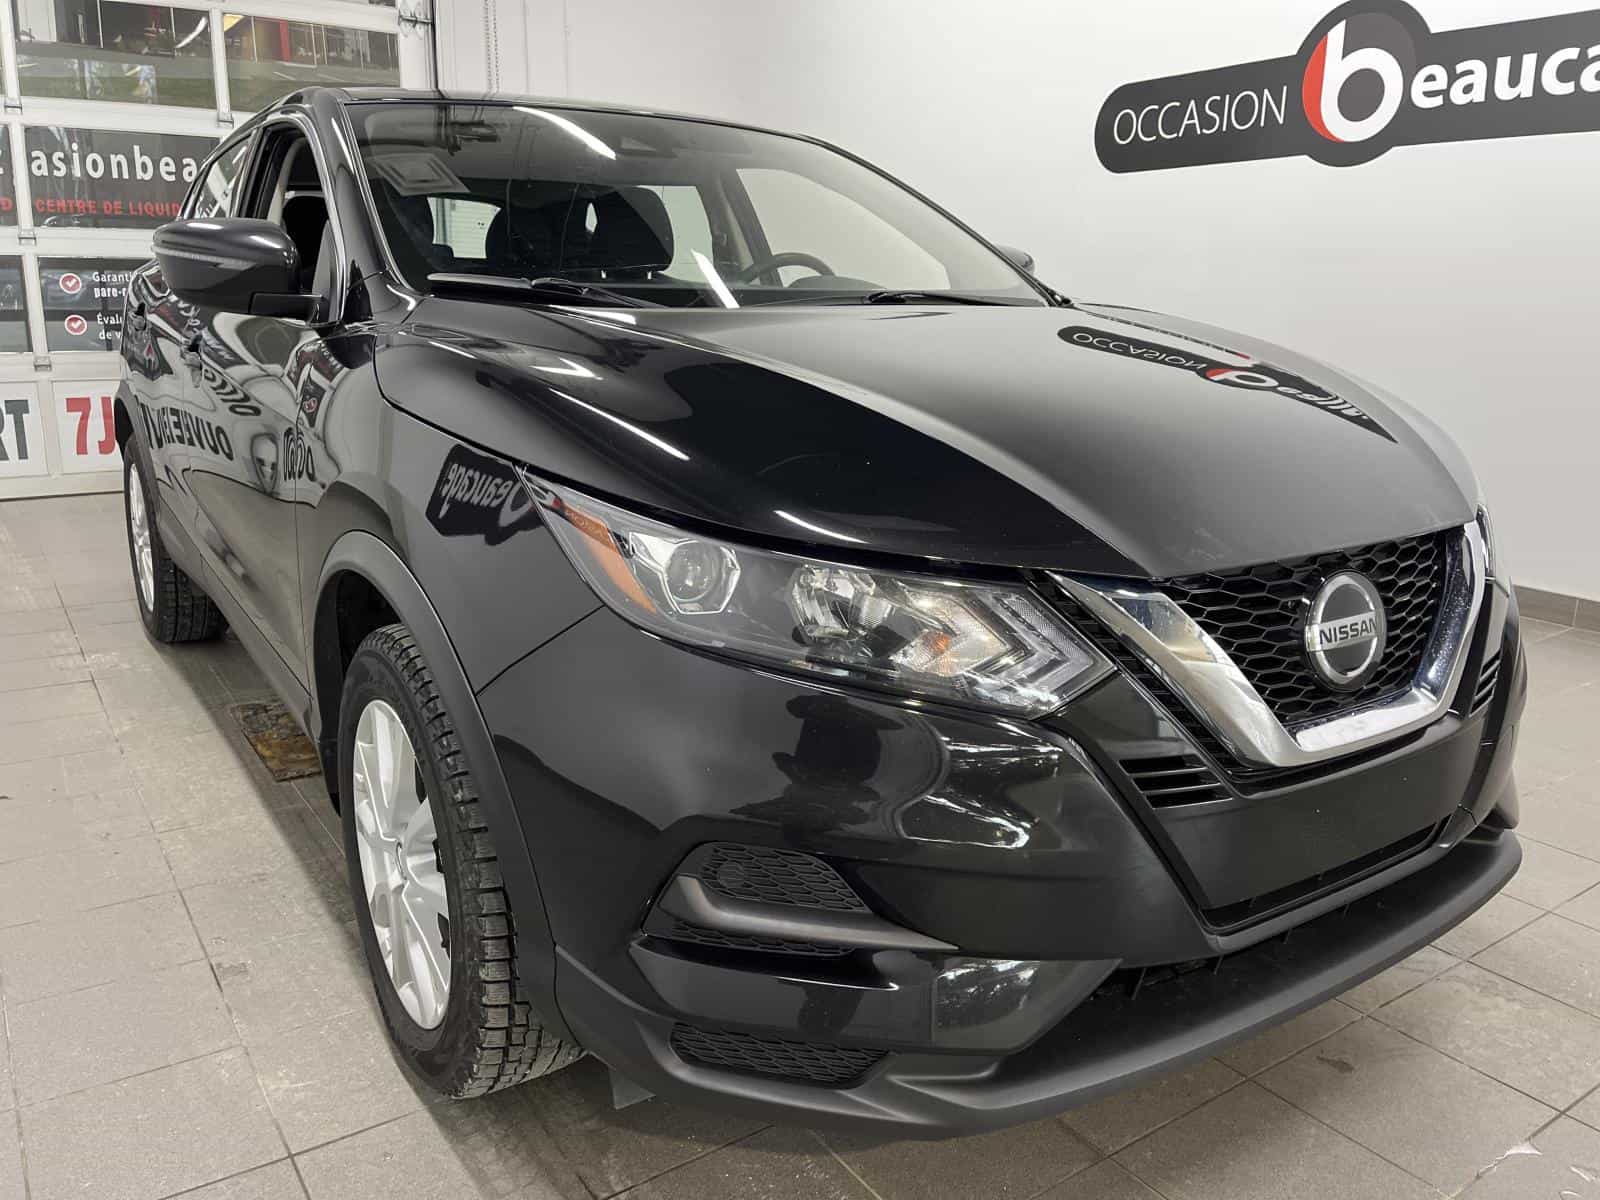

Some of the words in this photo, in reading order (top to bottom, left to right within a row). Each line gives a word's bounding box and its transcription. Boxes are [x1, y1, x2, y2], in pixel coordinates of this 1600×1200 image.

[1113, 85, 1288, 145] OCCASION
[35, 199, 97, 214] CENTRE
[103, 200, 123, 216] DE
[98, 329, 112, 340] de
[65, 396, 116, 456] 7J
[1319, 617, 1378, 645] NISSAN
